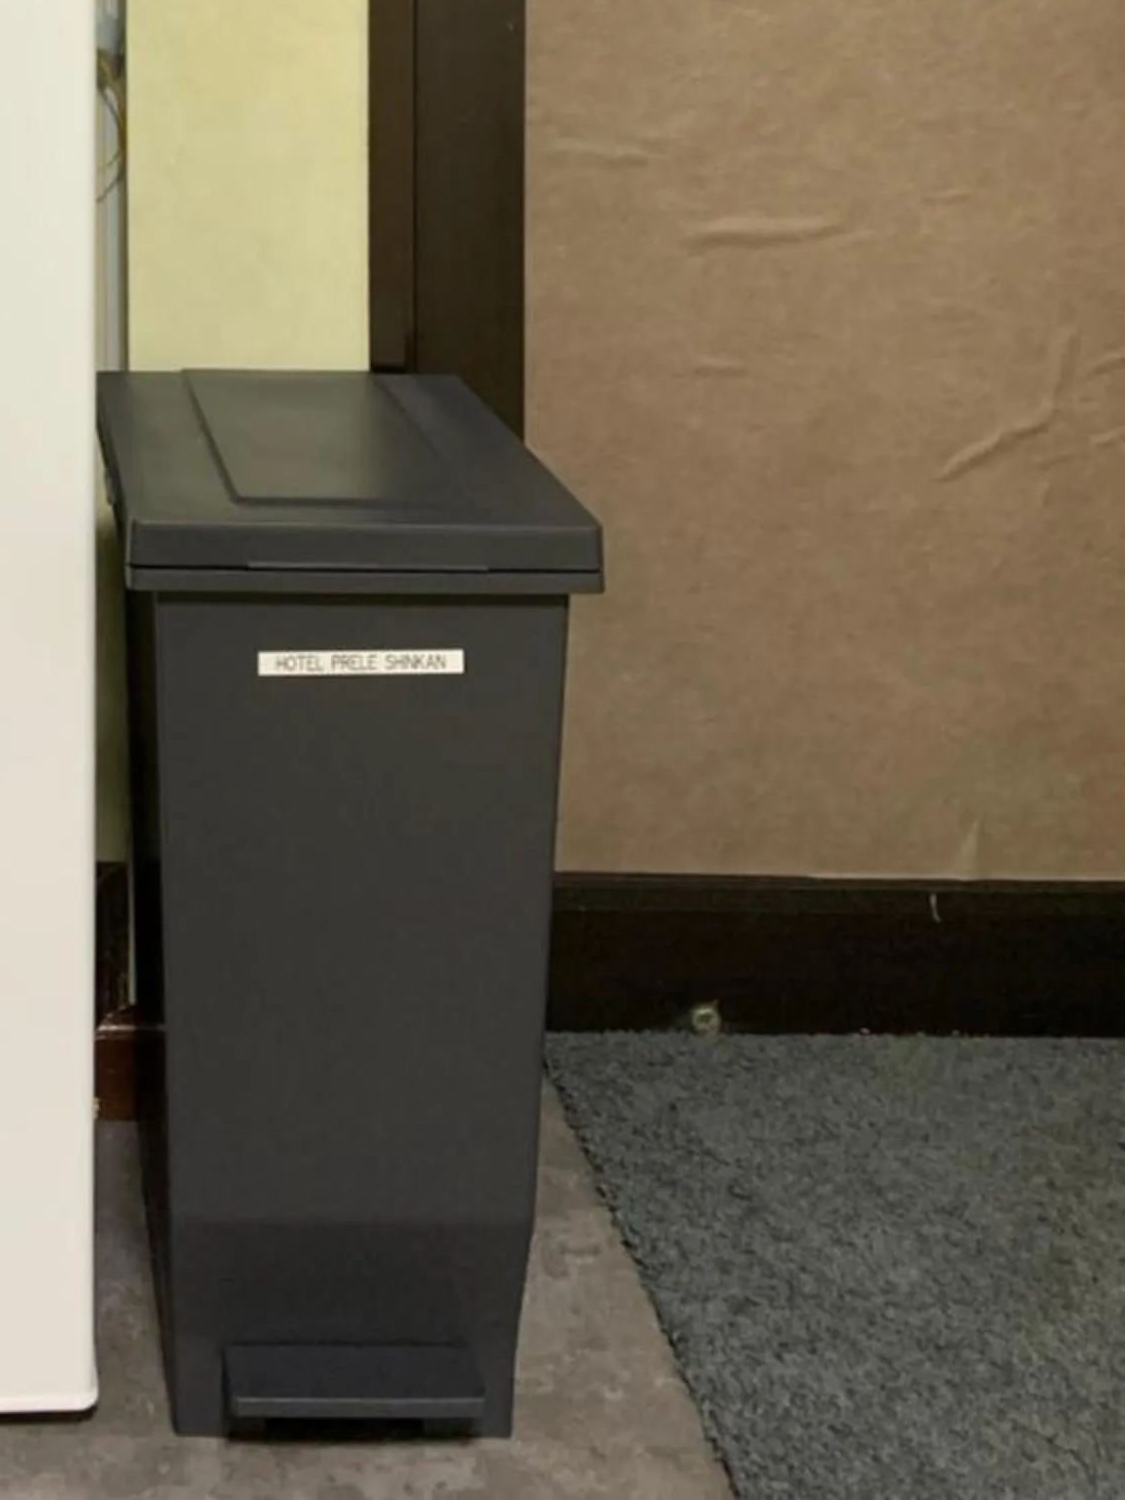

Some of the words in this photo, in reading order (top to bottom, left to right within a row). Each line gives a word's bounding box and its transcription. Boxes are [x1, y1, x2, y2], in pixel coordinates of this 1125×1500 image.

[276, 655, 323, 671] HOTEL
[331, 654, 377, 670] PRELE
[384, 653, 447, 670] SHINKAN
